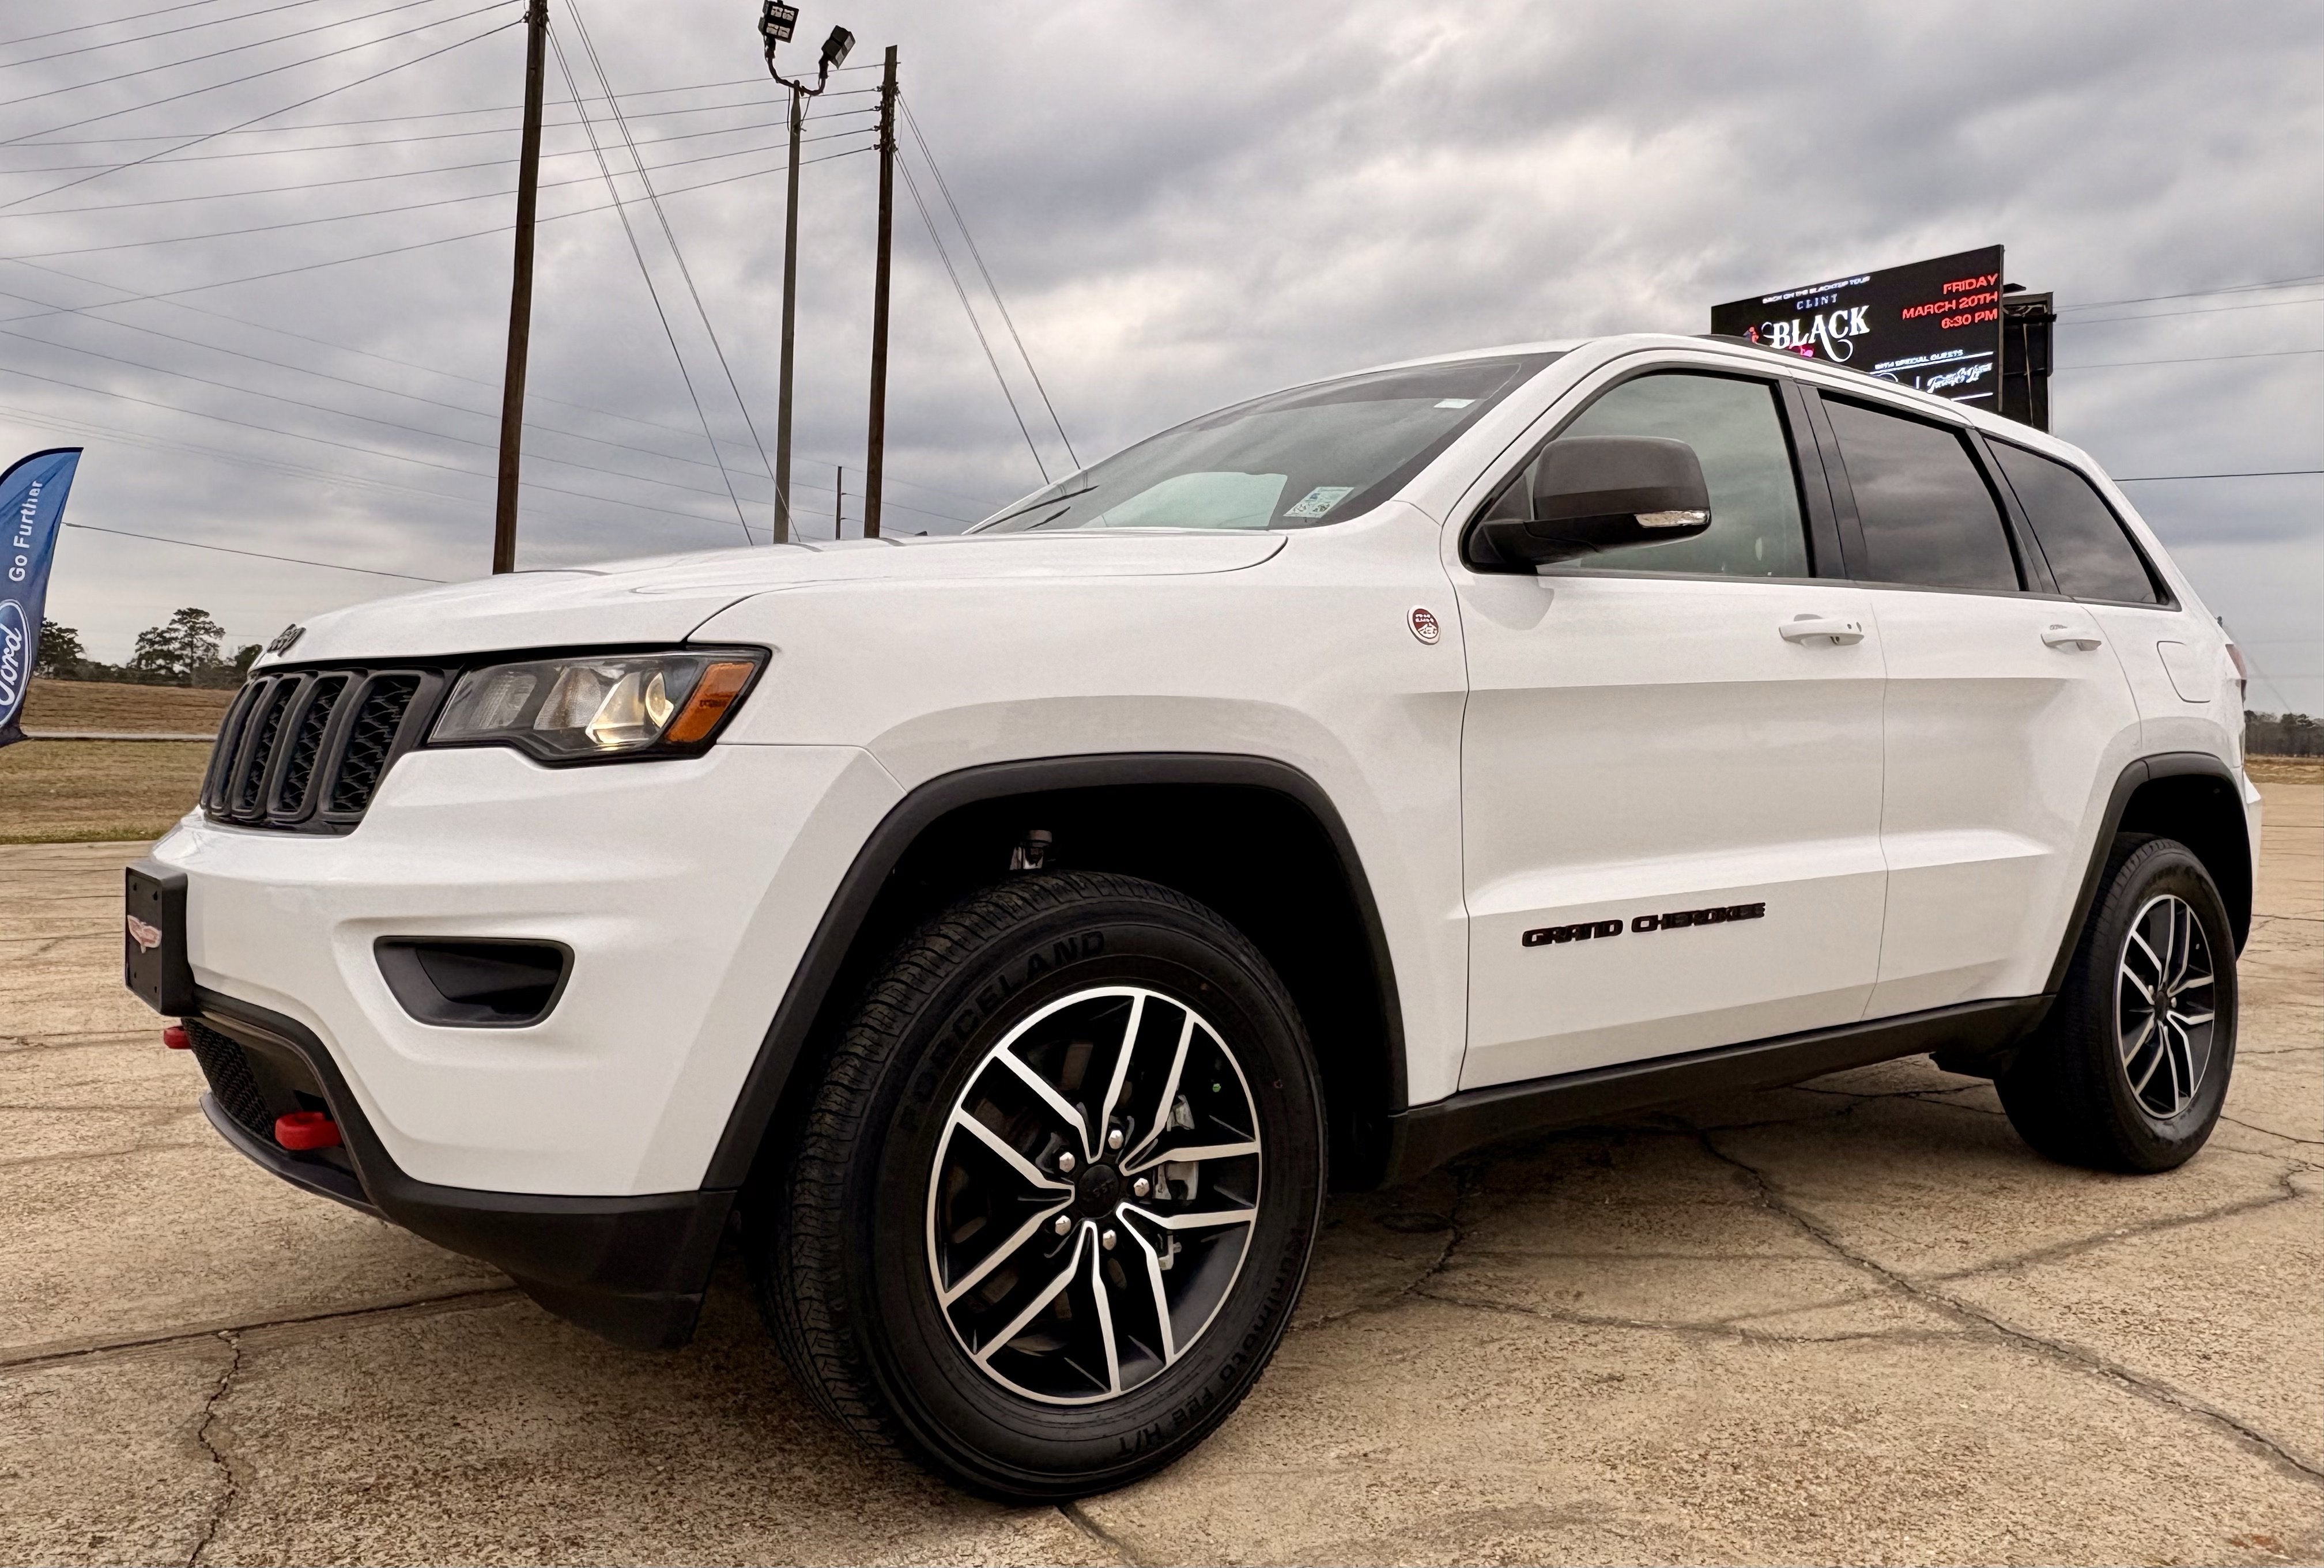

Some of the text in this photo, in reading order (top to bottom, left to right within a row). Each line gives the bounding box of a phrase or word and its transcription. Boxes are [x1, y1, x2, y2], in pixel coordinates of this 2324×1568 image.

[1943, 273, 1998, 294] FRIDAY
[1796, 293, 1838, 310] CLINT
[1902, 290, 1998, 320] MARCH 20TH
[1975, 308, 1998, 323] PM
[1761, 305, 1870, 362] BLACK
[9, 480, 43, 582] Go Further
[1522, 902, 1766, 947] GRAND CHEROKEE
